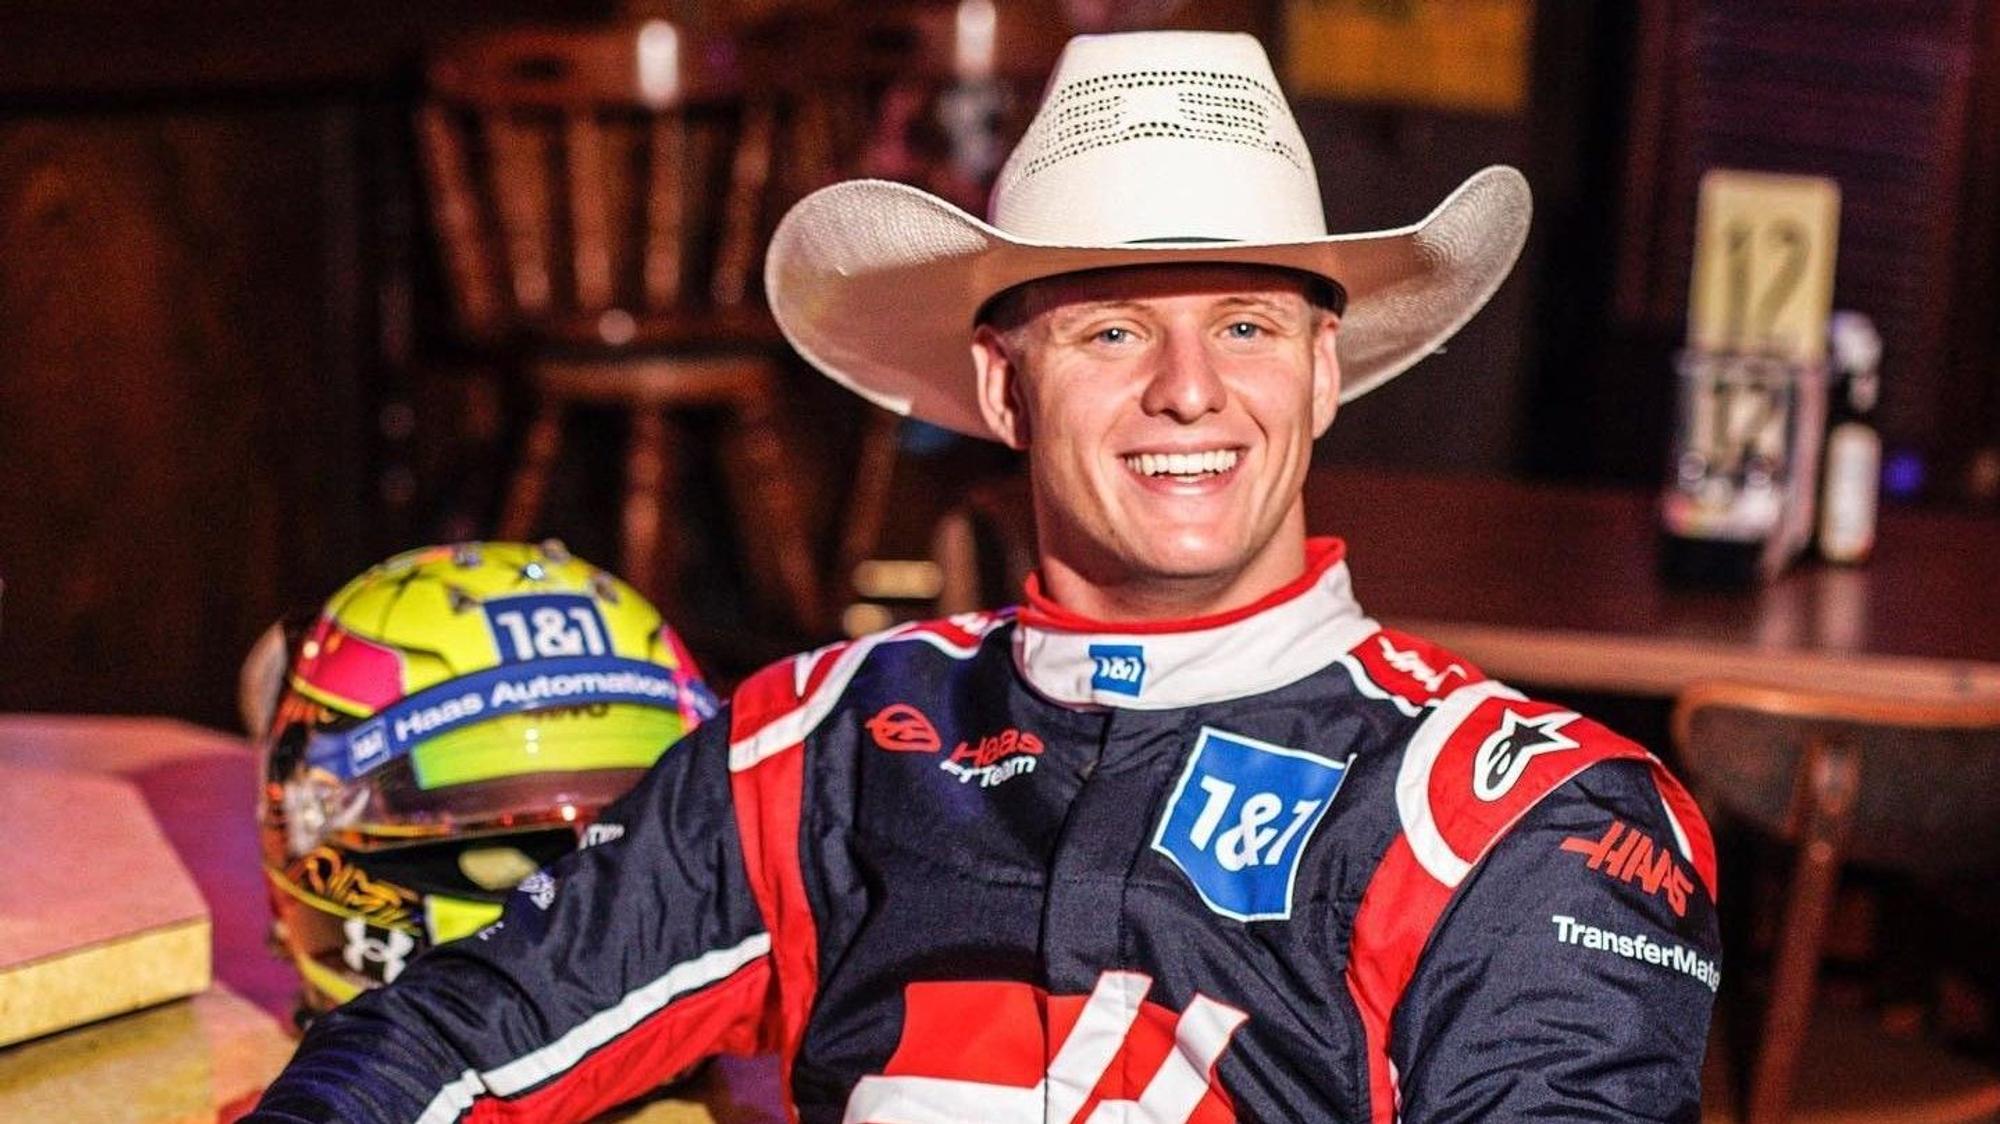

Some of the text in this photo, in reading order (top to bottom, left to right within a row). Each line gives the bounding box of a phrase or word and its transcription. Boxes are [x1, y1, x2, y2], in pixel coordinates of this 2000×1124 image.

[1729, 220, 1812, 350] 12
[496, 606, 606, 661] 1&1
[394, 692, 486, 742] Haas
[490, 669, 679, 708] Automation
[948, 727, 1045, 768] Haas
[1189, 774, 1323, 872] 1&1
[1559, 819, 1695, 918] HAAS
